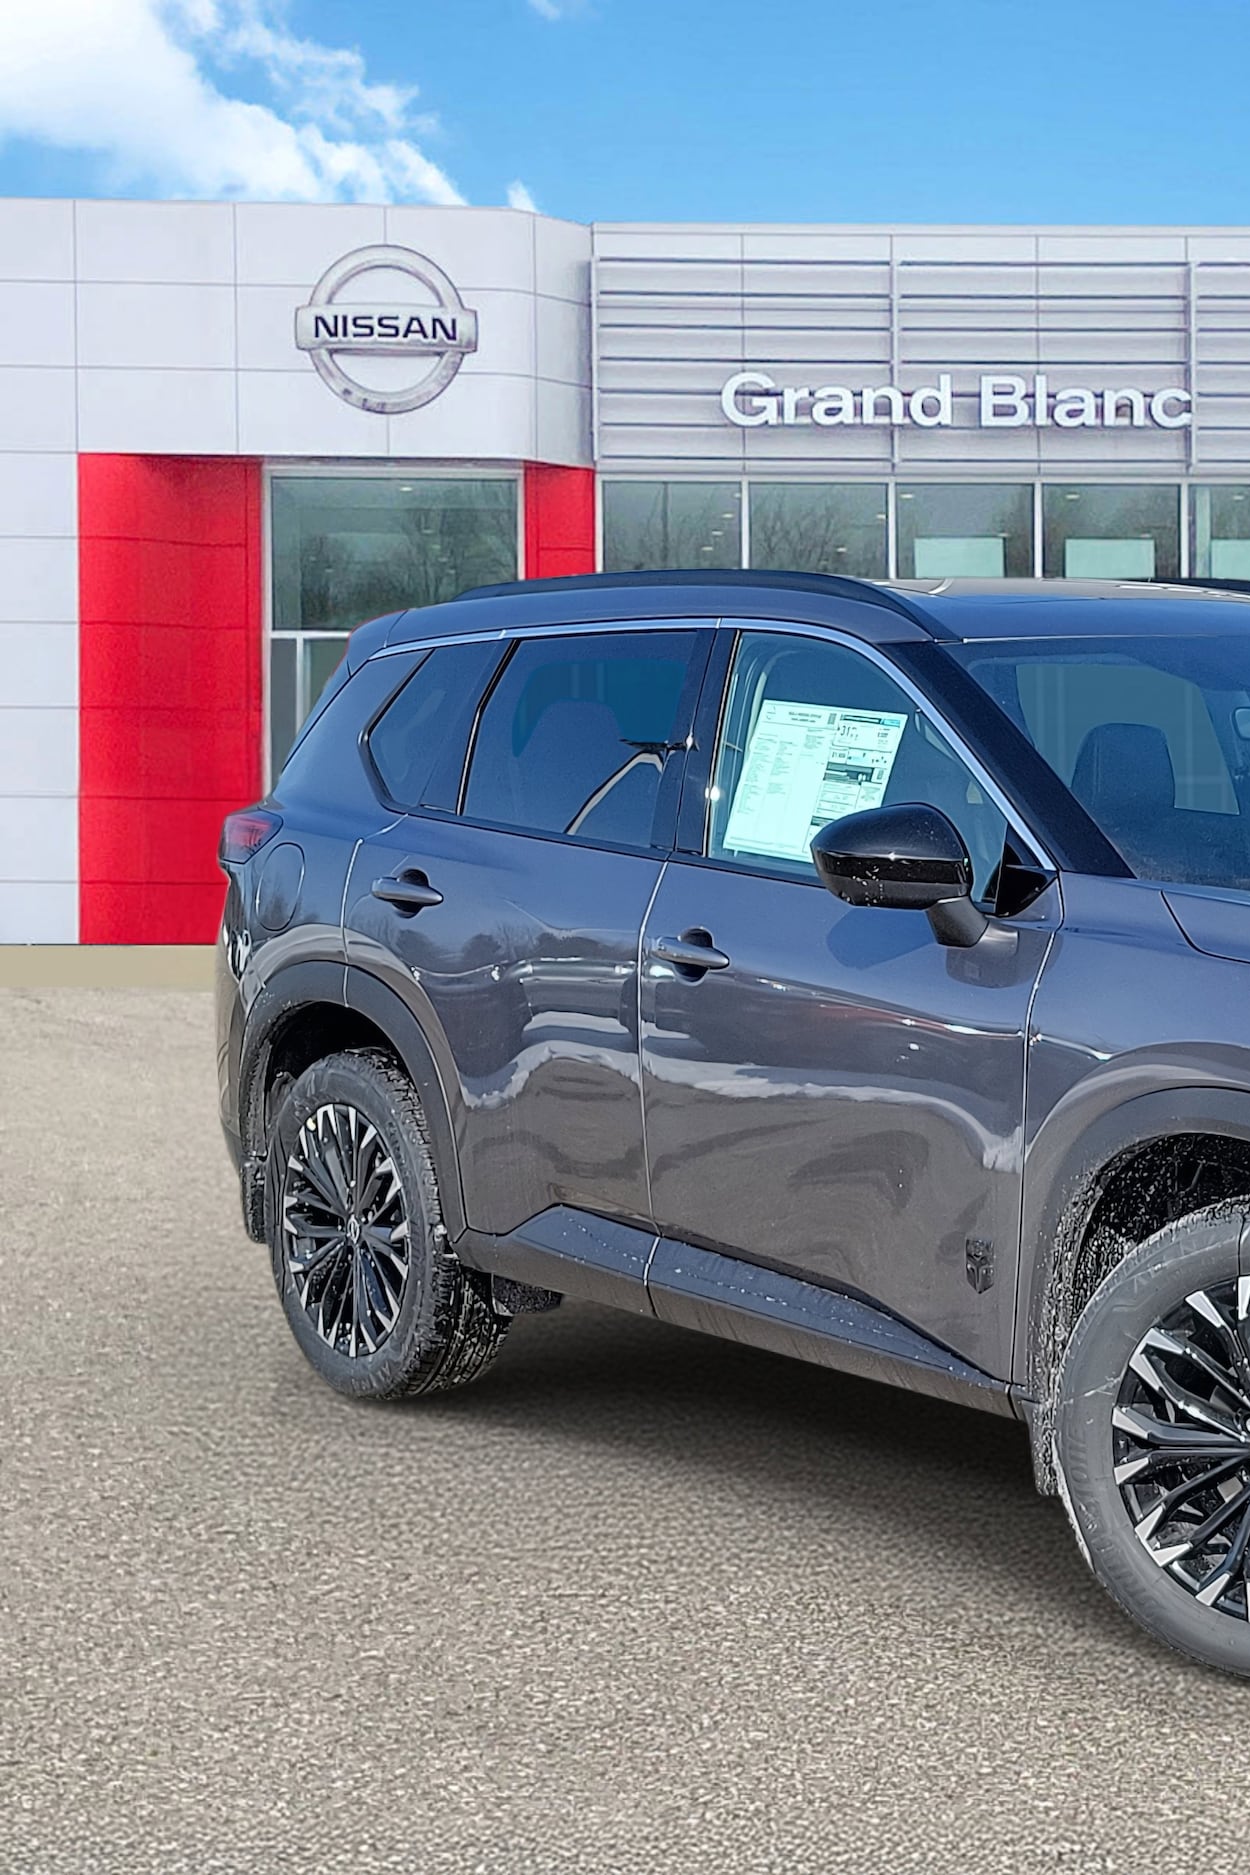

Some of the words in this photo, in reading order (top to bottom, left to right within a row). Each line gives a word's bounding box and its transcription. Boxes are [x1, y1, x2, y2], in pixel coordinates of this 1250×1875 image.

[314, 314, 458, 342] NISSAN
[720, 371, 953, 427] Grand
[979, 374, 1194, 429] Blanc
